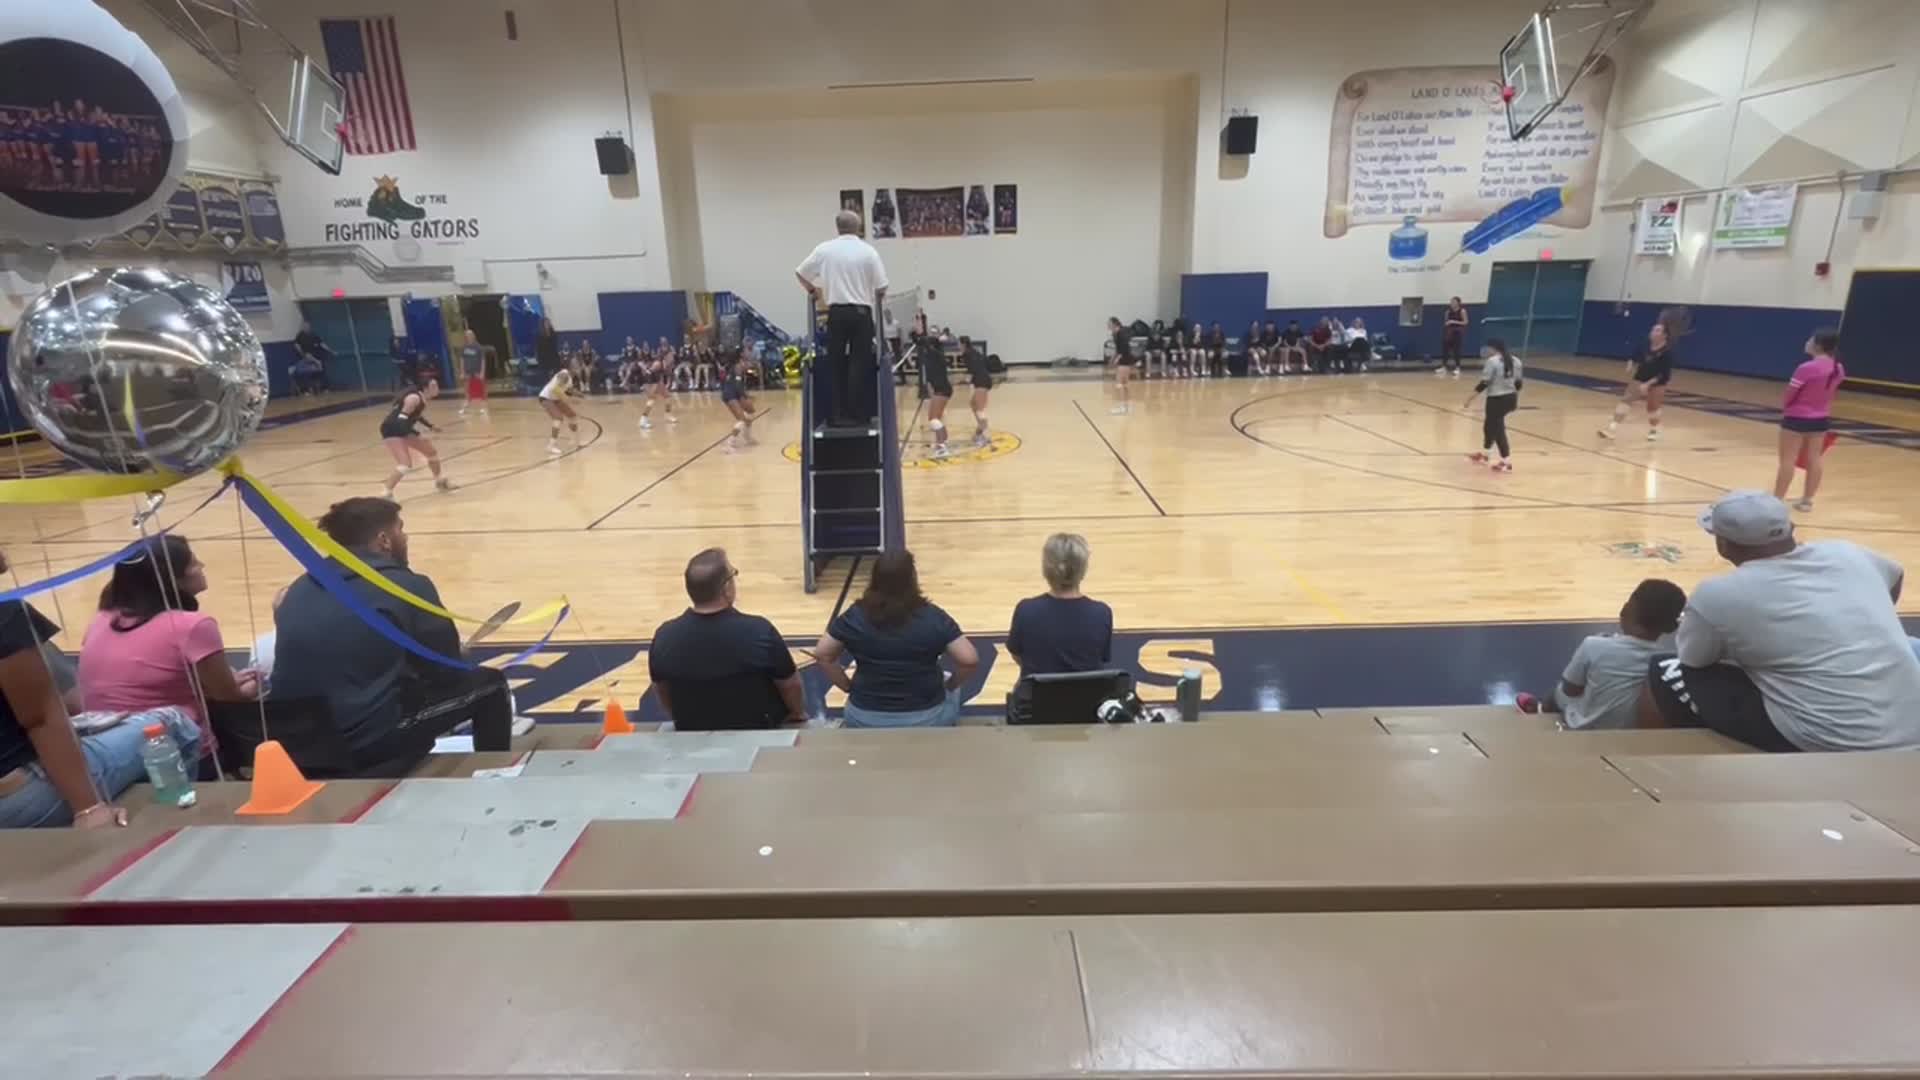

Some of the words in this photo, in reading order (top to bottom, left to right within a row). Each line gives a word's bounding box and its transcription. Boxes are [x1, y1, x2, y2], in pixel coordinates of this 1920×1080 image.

[1411, 87, 1439, 98] LAND
[334, 198, 363, 209] HOME
[414, 195, 426, 205] OF
[429, 194, 447, 204] THE
[325, 221, 400, 242] FIGHTING
[411, 218, 480, 239] GATORS
